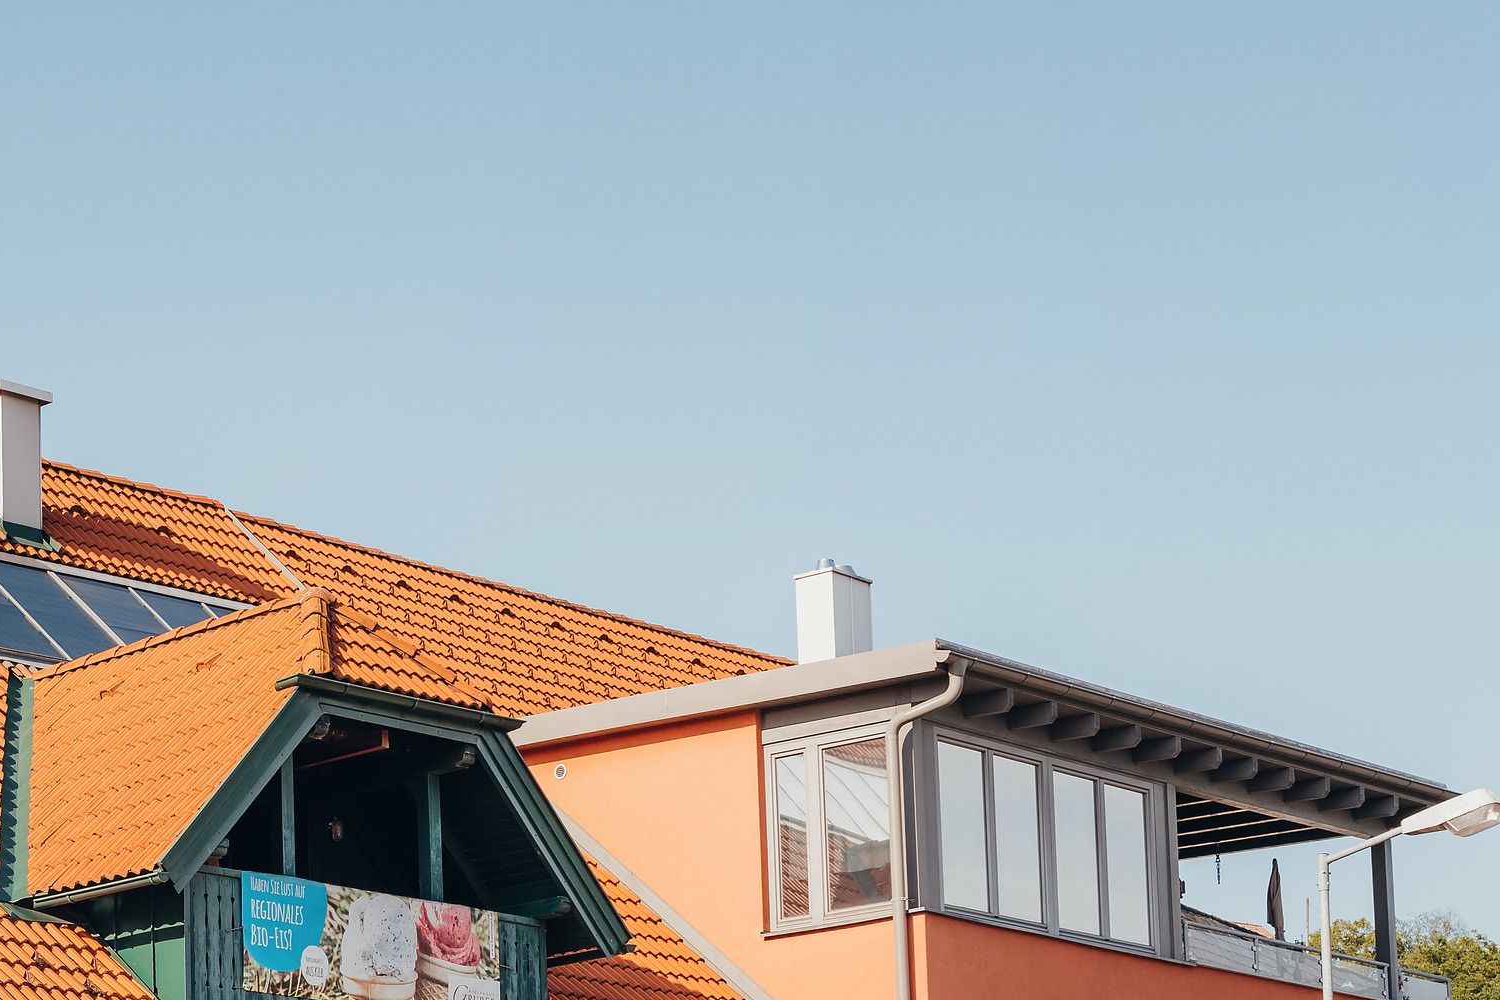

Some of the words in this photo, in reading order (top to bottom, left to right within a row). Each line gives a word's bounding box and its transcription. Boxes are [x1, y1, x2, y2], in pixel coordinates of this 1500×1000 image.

[250, 876, 269, 893] HABEN
[250, 899, 304, 925] REGIONALES
[250, 923, 293, 950] BIO-EIS?
